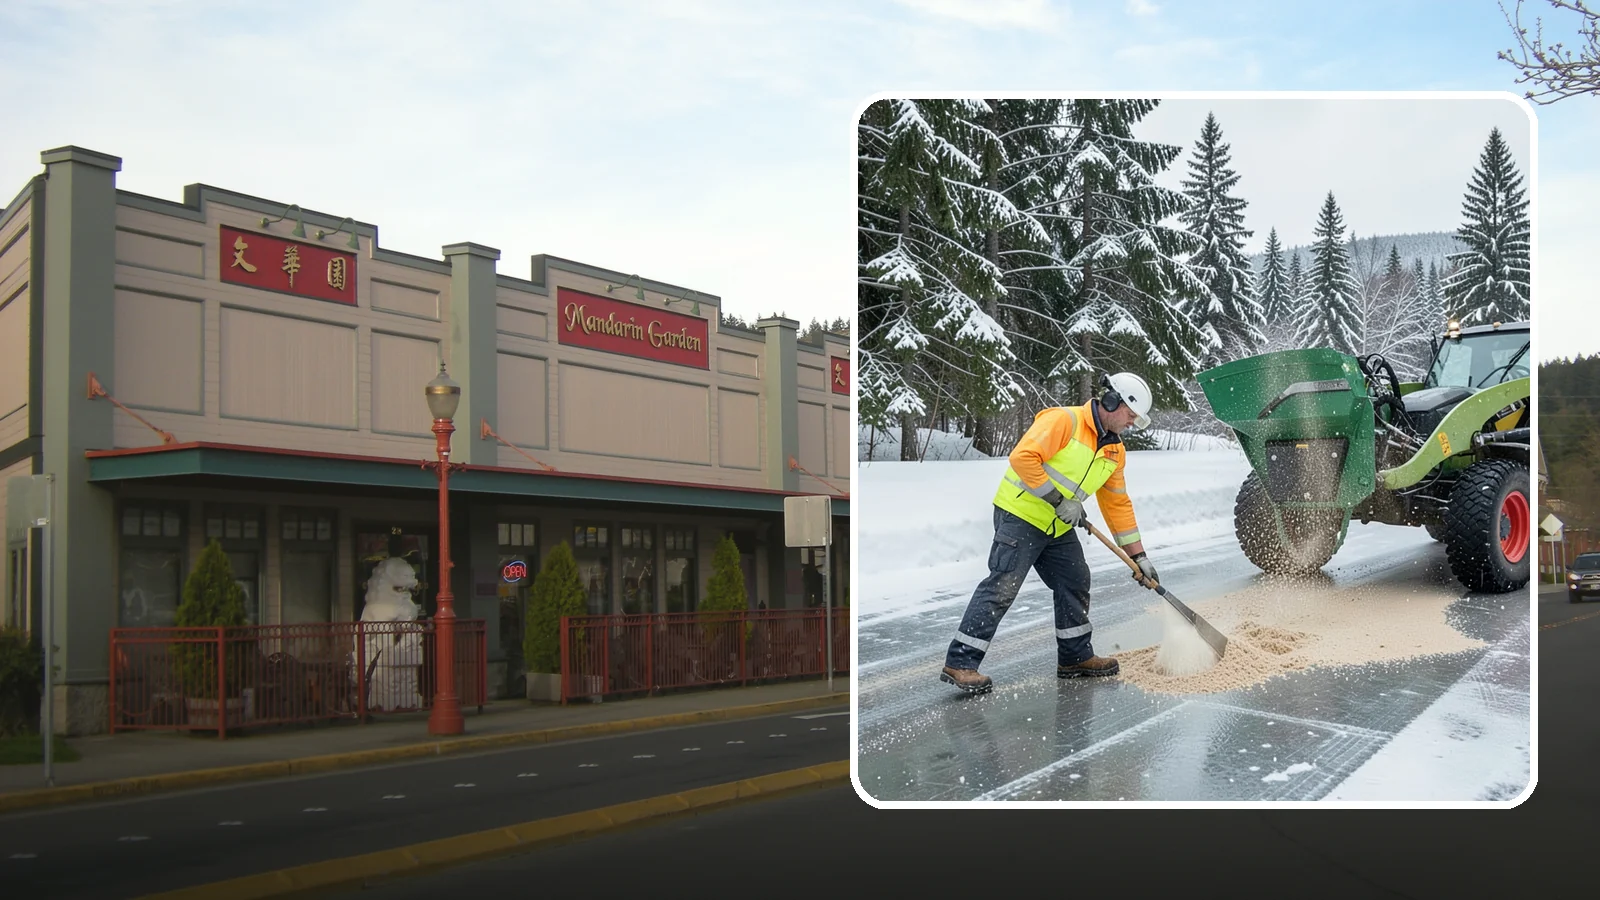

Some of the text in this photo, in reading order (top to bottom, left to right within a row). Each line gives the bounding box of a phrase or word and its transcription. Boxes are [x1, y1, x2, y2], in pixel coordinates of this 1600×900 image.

[231, 235, 346, 291] 文華園
[564, 302, 702, 352] Mandarin Garden
[503, 565, 527, 579] OPEN
